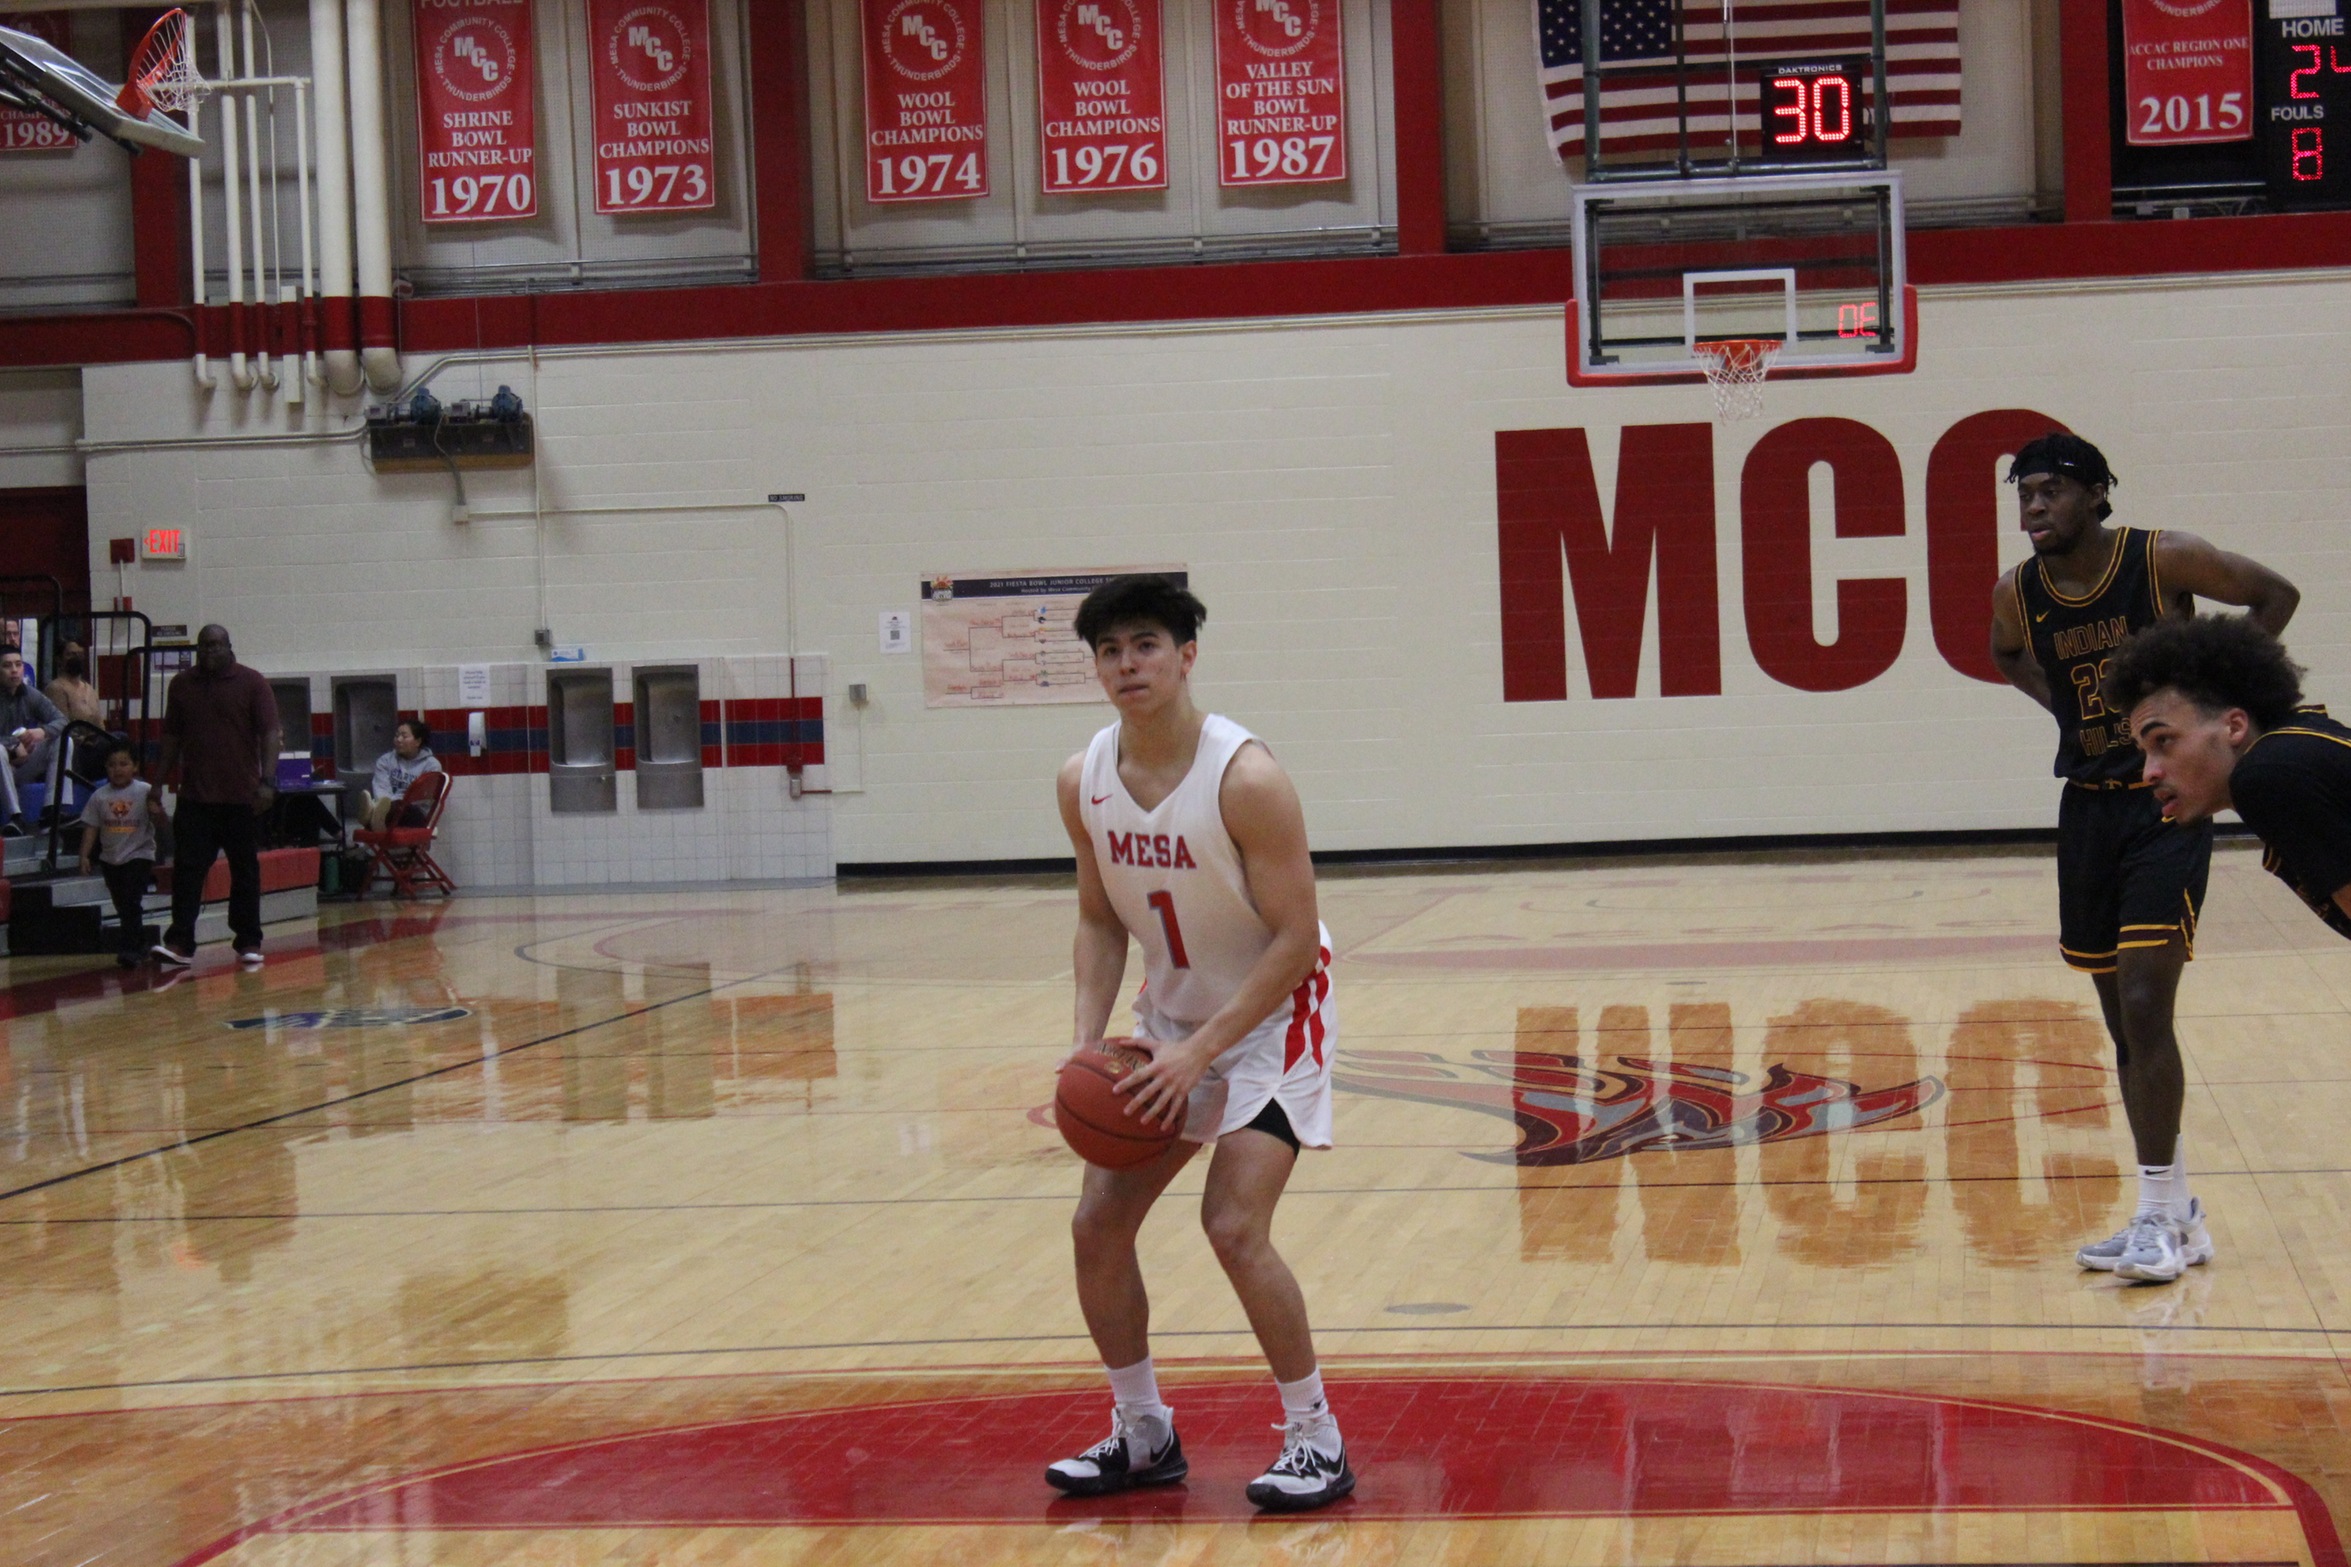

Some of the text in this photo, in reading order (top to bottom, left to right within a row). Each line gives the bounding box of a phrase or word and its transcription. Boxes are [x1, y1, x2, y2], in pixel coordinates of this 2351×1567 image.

[1058, 0, 1141, 43] MESA OLLEGE
[2151, 0, 2221, 17] HUNDERBIR
[609, 7, 691, 65] MESA COMMUNITY COLLEGE
[882, 24, 892, 54] MESA
[943, 3, 965, 50] COLLEGE
[902, 15, 947, 60] MCC
[1078, 4, 1123, 50] MCC
[2281, 18, 2345, 38] HOME
[434, 17, 516, 74] MESA COMMUNITY COLLEGE
[628, 26, 673, 72] MCC
[1243, 30, 1315, 57] THUNDERBIRDS
[2129, 37, 2248, 55] ACCAC REGION ONE
[453, 36, 499, 82] MCC
[890, 54, 961, 81] THUNDERBIRDS
[1065, 44, 1137, 71] THUNDERBIRDS
[1245, 61, 1313, 79] VALLEY
[1778, 64, 1843, 75] DAKTRONICS
[2146, 55, 2223, 71] CHAMPIONS
[442, 75, 512, 102] THUNDERBIRDS
[617, 65, 687, 92] THUNDERBIRDS
[1073, 80, 1131, 97] WOOL
[1226, 78, 1334, 99] OF THE SUN
[613, 100, 692, 119] SUNKIST
[897, 91, 955, 109] WOOL
[1075, 99, 1131, 117] BOWL
[1254, 98, 1309, 116] BOWL
[1773, 76, 1849, 143] 30
[2139, 92, 2243, 133] 2015
[2271, 105, 2324, 122] FOULS
[443, 110, 513, 128] SHRINE
[627, 120, 681, 138] BOWL
[899, 110, 956, 127] BOWL
[1045, 117, 1161, 138] CHAMPIONS
[1226, 115, 1337, 135] RUNNER-UP
[3, 121, 70, 148] 1989
[452, 129, 507, 147] BOWL
[871, 124, 984, 146] CHAMPIONS
[428, 148, 533, 168] RUNNER-UP
[599, 138, 710, 159] CHAMPIONS
[1229, 136, 1335, 178] 1987
[2291, 127, 2323, 181] 8
[877, 152, 981, 195] 1974
[1052, 143, 1158, 186] 1976
[431, 173, 532, 215] 1970
[605, 164, 707, 206] 1973
[149, 529, 181, 554] EXIT
[1494, 408, 2076, 703] MCC
[2053, 616, 2128, 660] INDIAN
[2070, 658, 2121, 720] 2
[1107, 830, 1197, 870] MESA
[1147, 889, 1191, 970] 1
